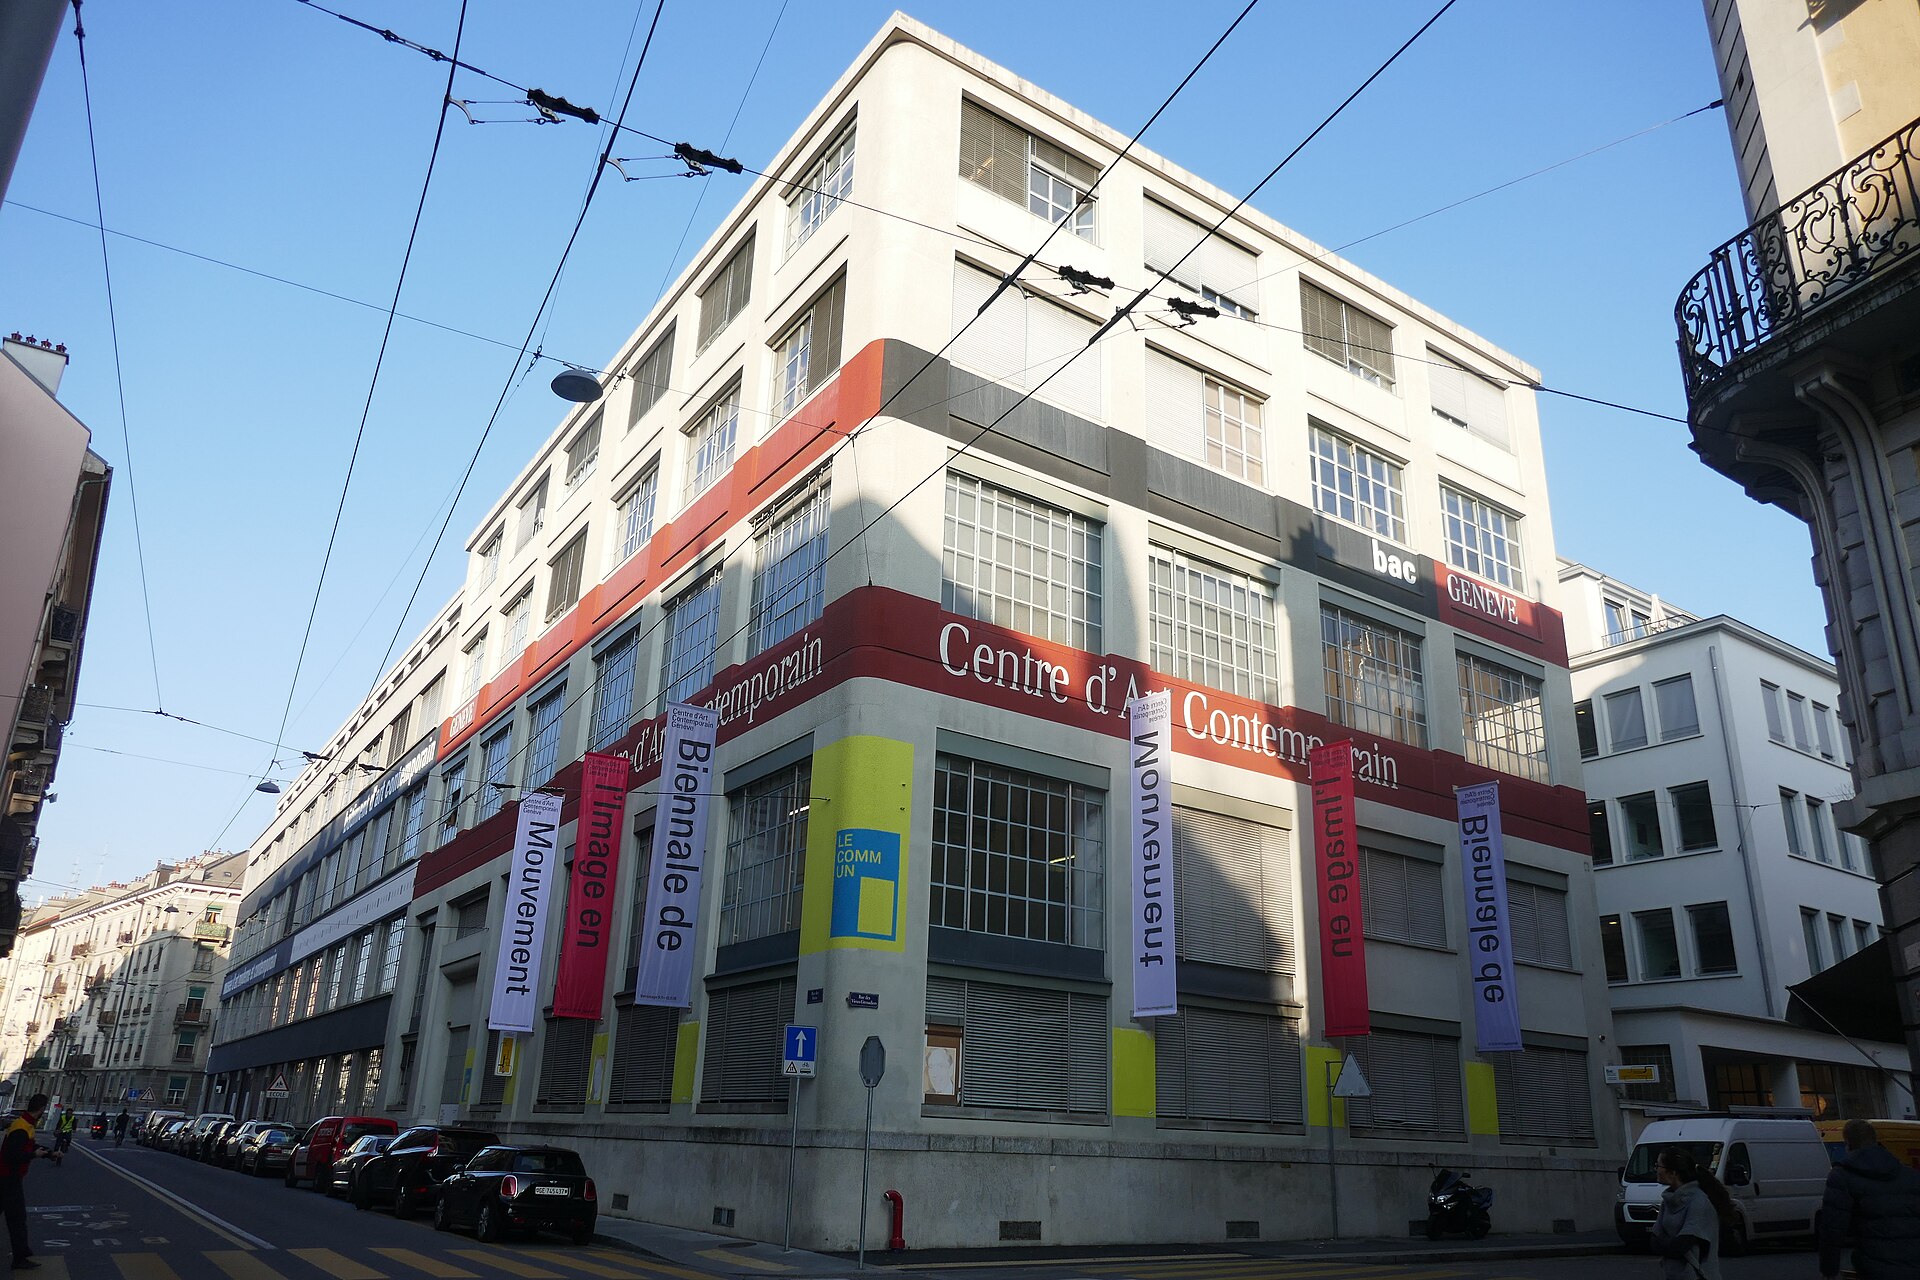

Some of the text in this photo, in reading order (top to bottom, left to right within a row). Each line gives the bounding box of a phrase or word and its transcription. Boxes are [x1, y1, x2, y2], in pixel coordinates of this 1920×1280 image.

[1371, 538, 1417, 585] bac
[1446, 573, 1519, 625] GENEVE
[939, 622, 1070, 704] Centre
[672, 708, 709, 720] Centre d'Art
[672, 715, 714, 729] Contemporain
[661, 738, 712, 894] Biennale
[837, 849, 882, 864] COMM
[838, 833, 854, 848] LE
[836, 864, 855, 878] UN
[505, 821, 556, 998] Mouvement
[577, 910, 602, 949] en
[656, 905, 694, 952] de
